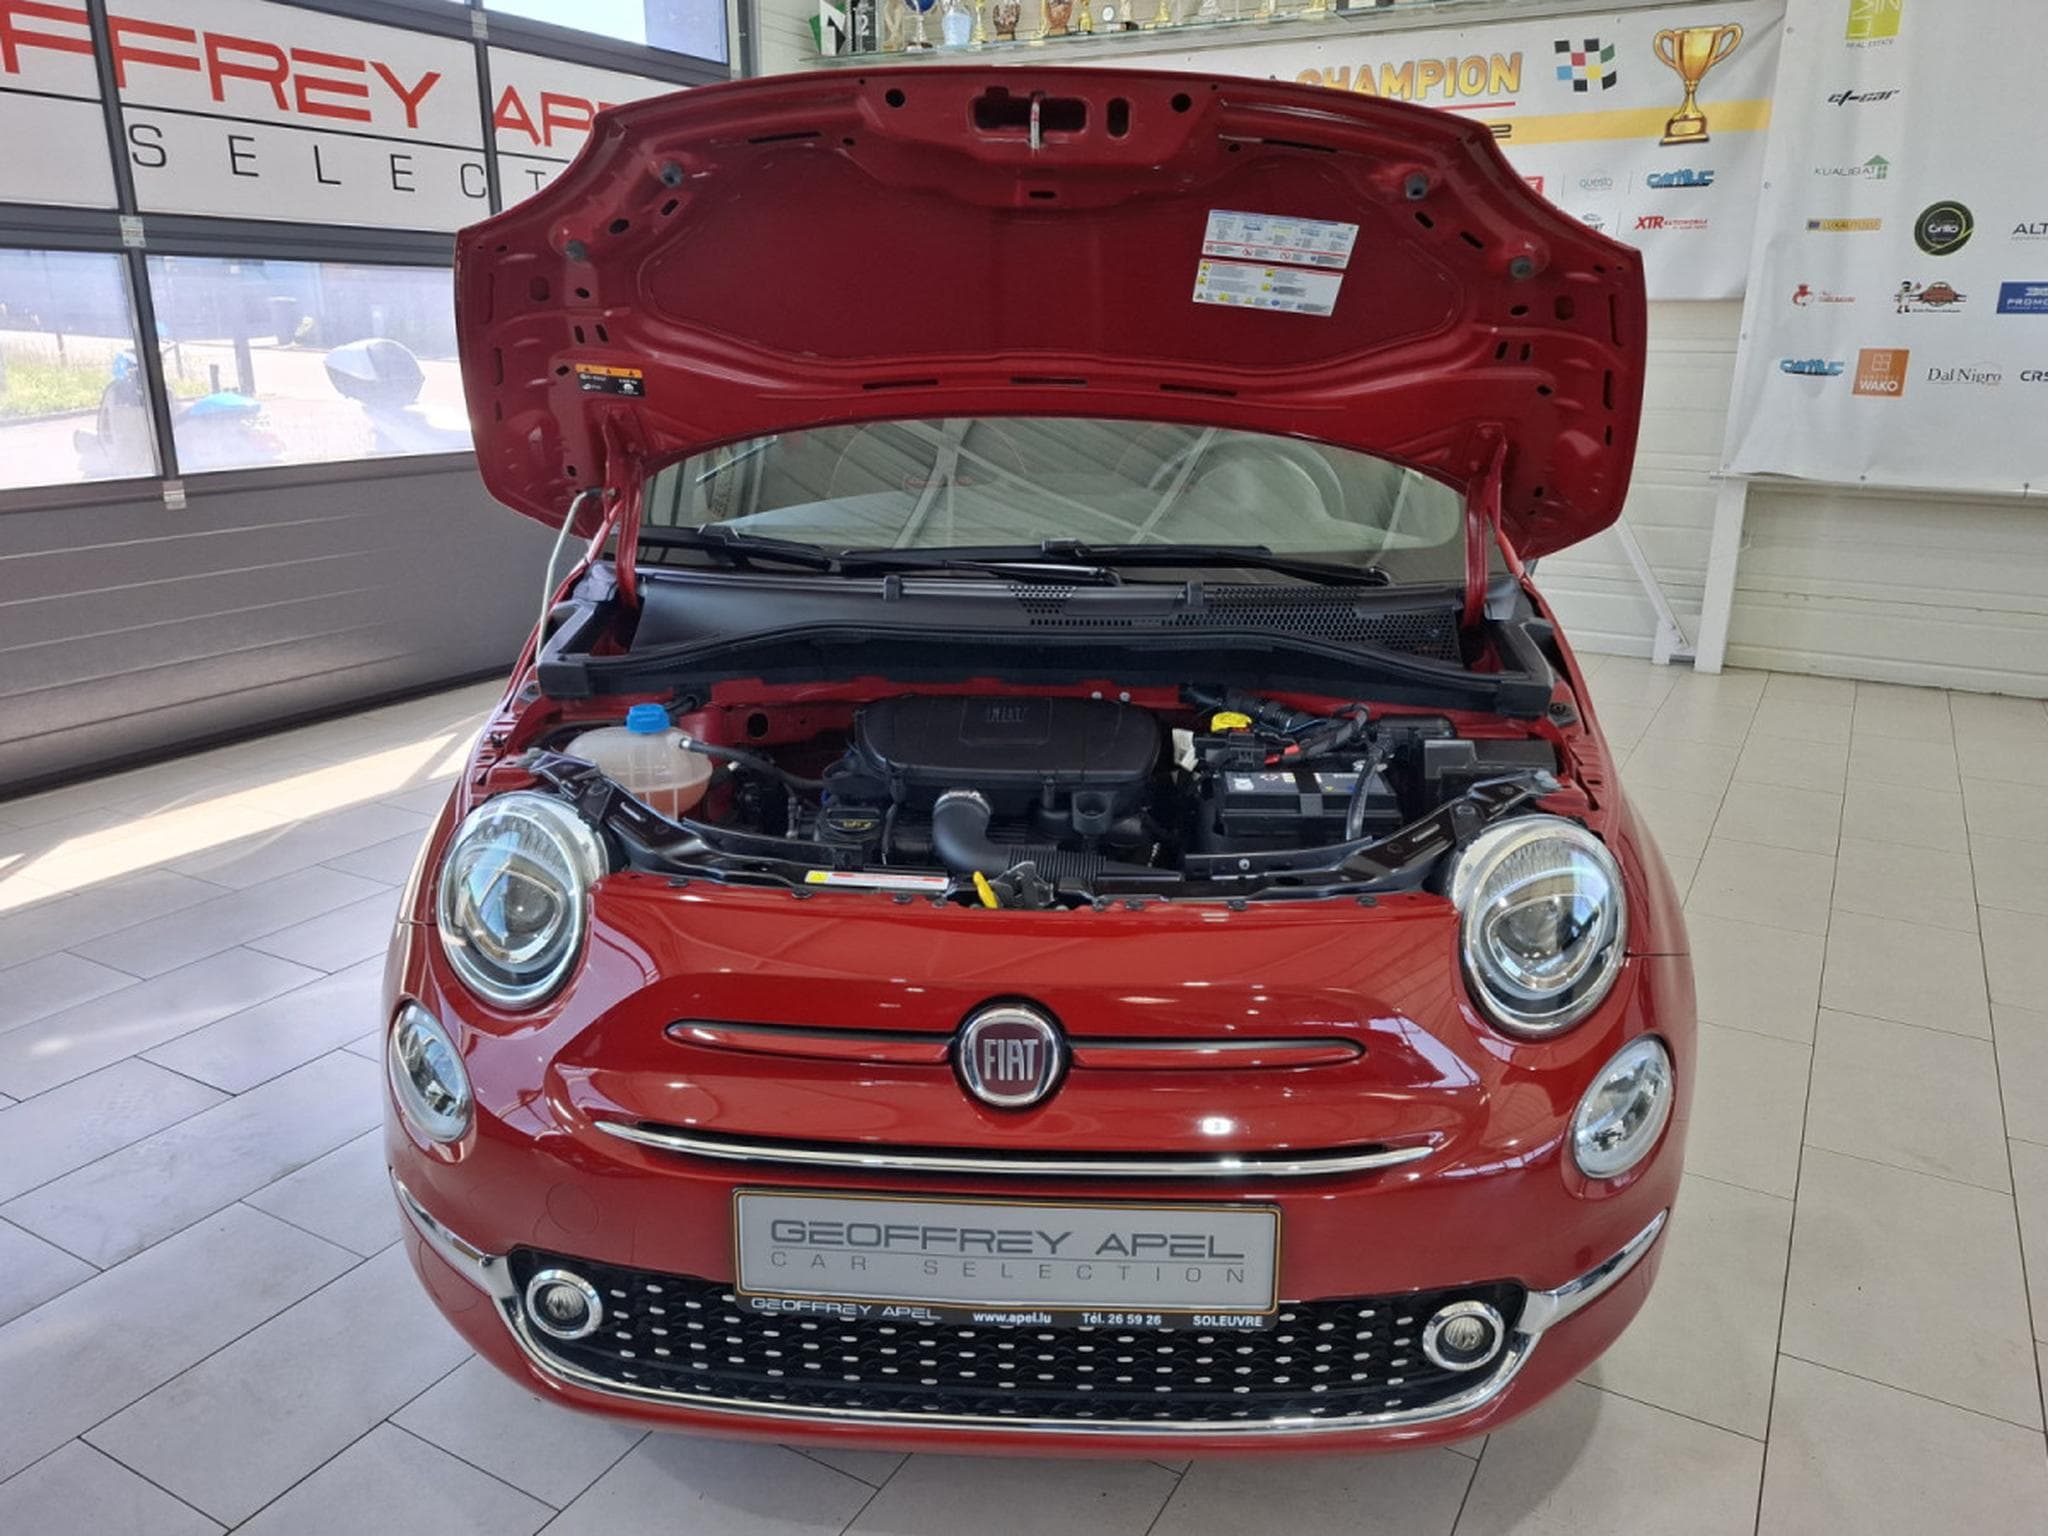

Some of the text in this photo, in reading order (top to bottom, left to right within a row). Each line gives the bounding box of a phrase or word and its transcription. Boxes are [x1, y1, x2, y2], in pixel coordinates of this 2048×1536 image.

[493, 84, 617, 147] AP
[1634, 215, 1665, 230] XTR
[1859, 379, 1899, 393] WAKO
[1927, 367, 2002, 385] Dal Nigro
[984, 1039, 1038, 1081] FIAT
[771, 1219, 1245, 1259] GEOFFREY APEL
[771, 1252, 1245, 1284] CAR SELECTION
[751, 1297, 872, 1316] GEOFFREY
[881, 1305, 942, 1321] APEL
[973, 1311, 1052, 1325] www.apel.lu
[1082, 1312, 1105, 1325] Tél.
[1108, 1313, 1124, 1325] 26
[1126, 1313, 1143, 1325] 59
[1193, 1314, 1263, 1328] SOLEUVRE
